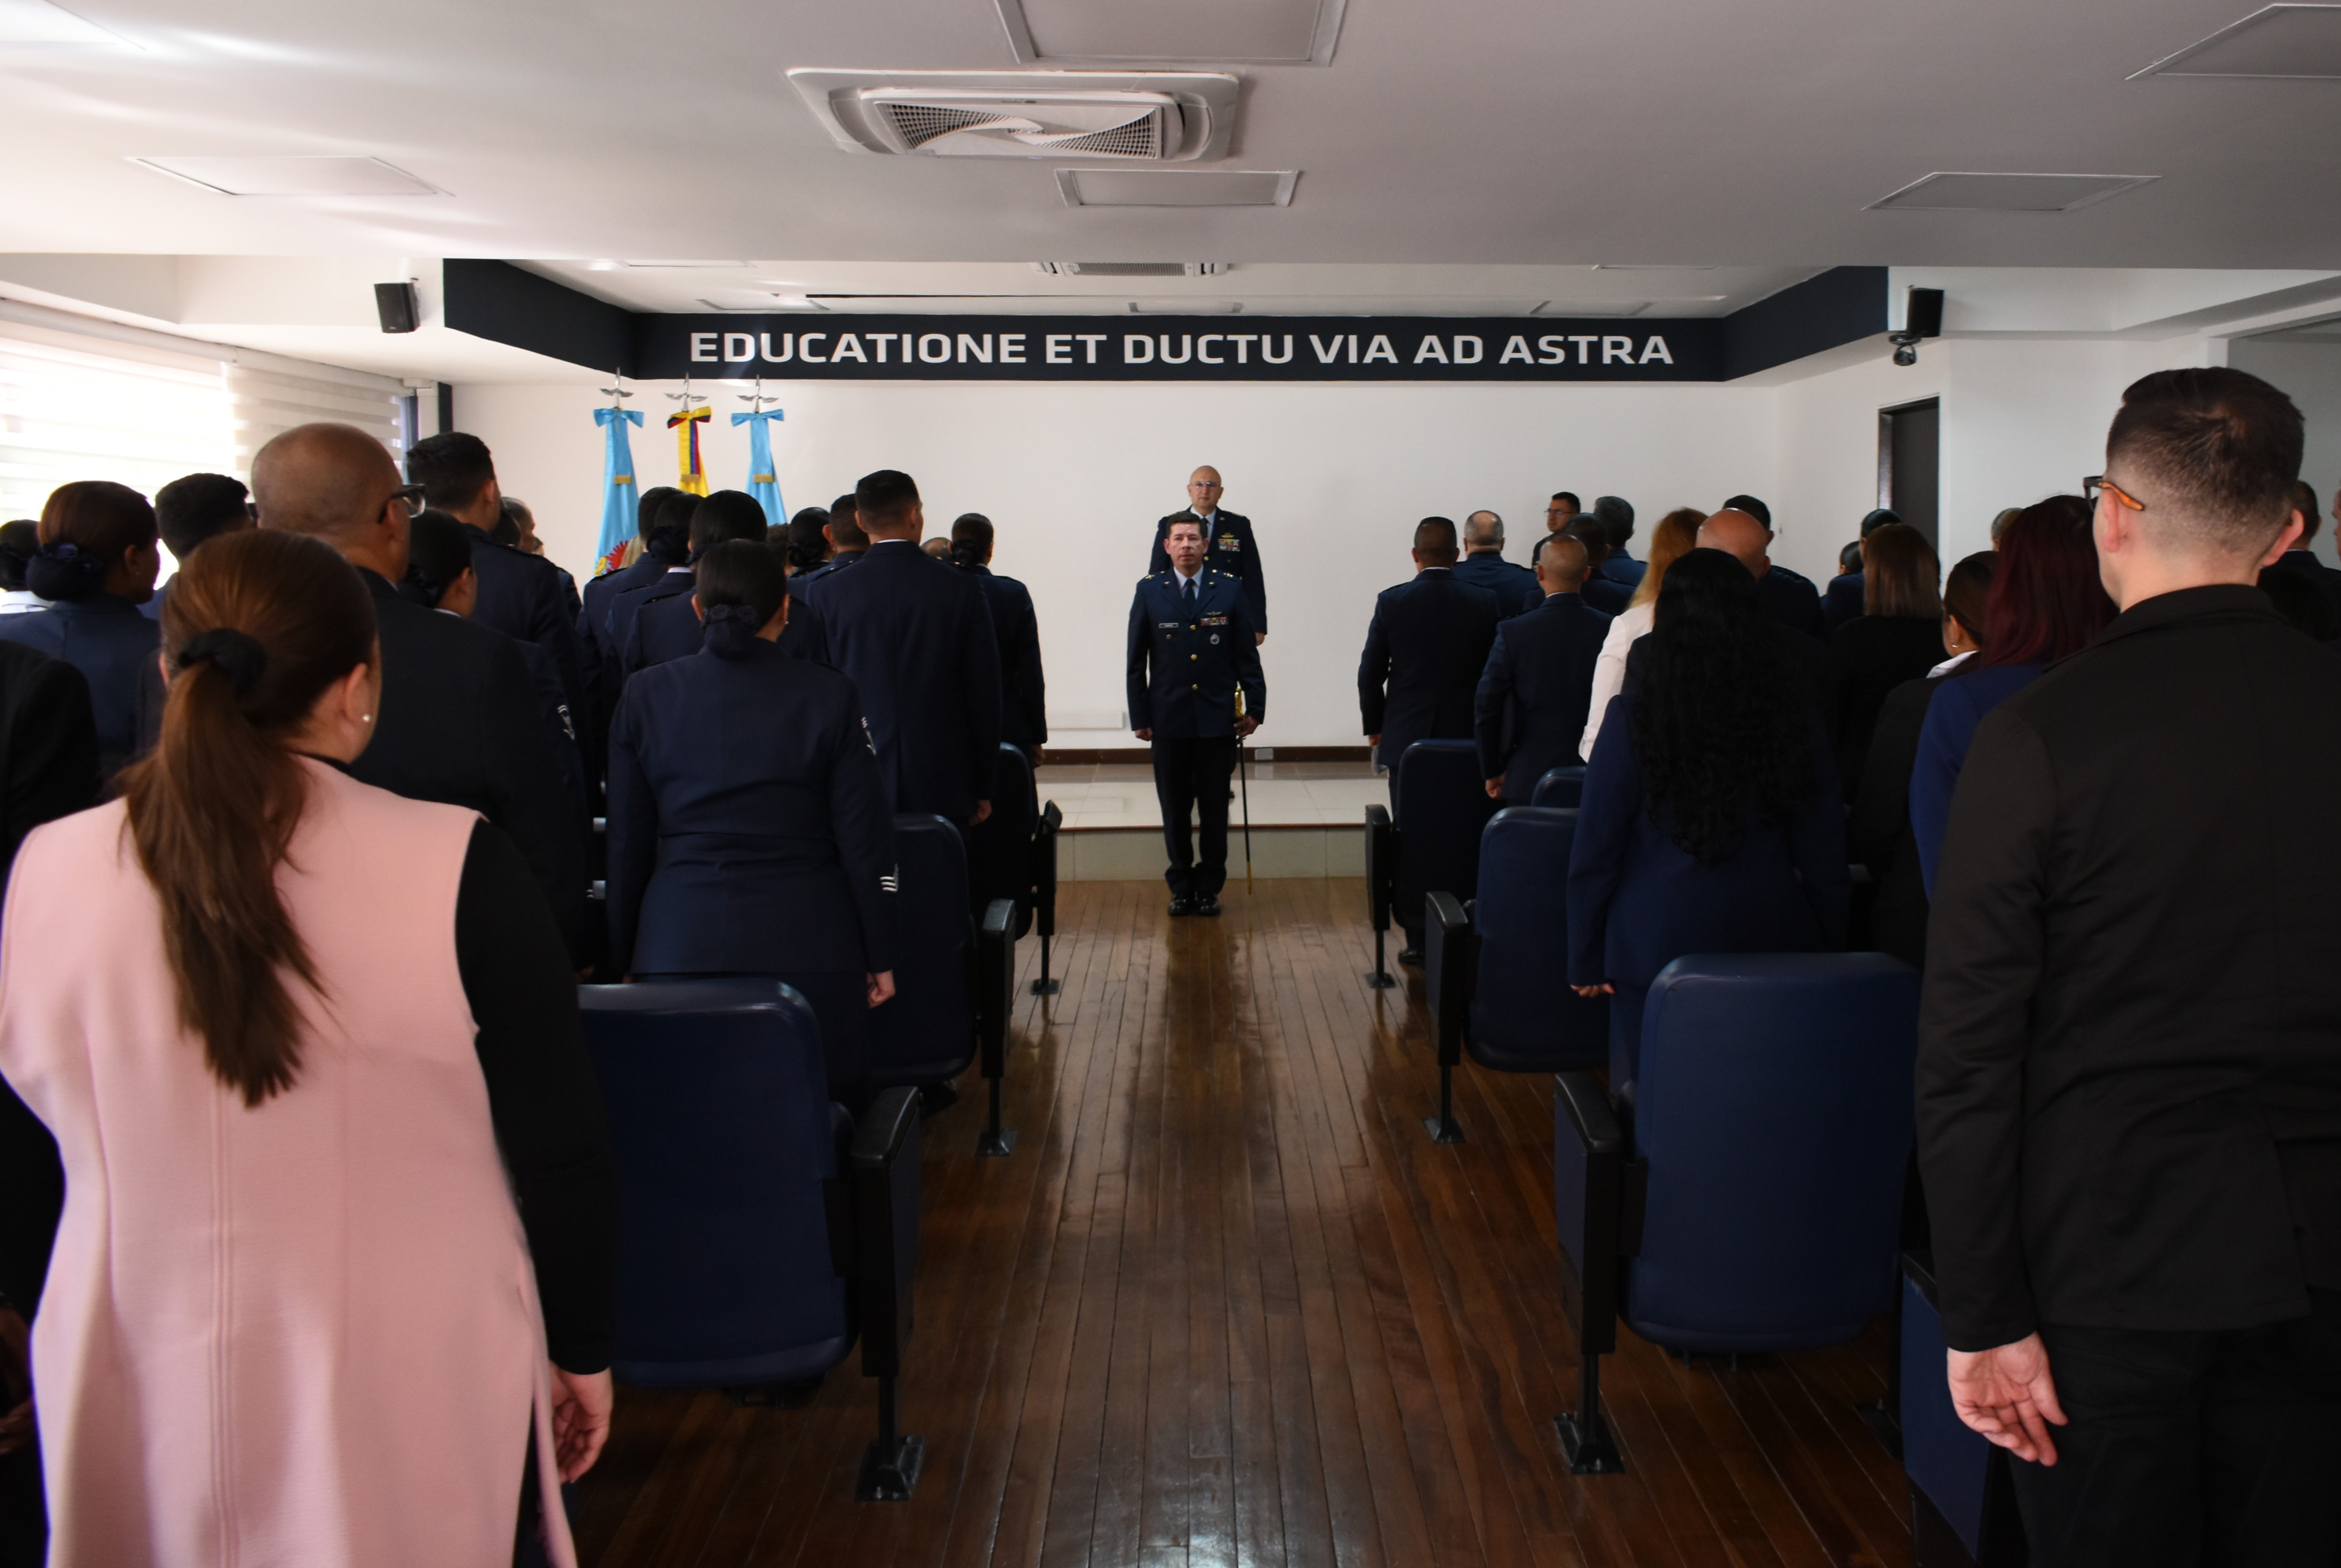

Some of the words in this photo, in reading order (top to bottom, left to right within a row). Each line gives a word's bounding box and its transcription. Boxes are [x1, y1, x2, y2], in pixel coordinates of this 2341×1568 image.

[690, 332, 1027, 363] EDUCATIONE
[1045, 334, 1107, 364] ET
[1123, 334, 1293, 364] DUCTU
[1308, 334, 1398, 364] VIA
[1413, 335, 1483, 364] AD
[1499, 335, 1673, 364] ASTRA
